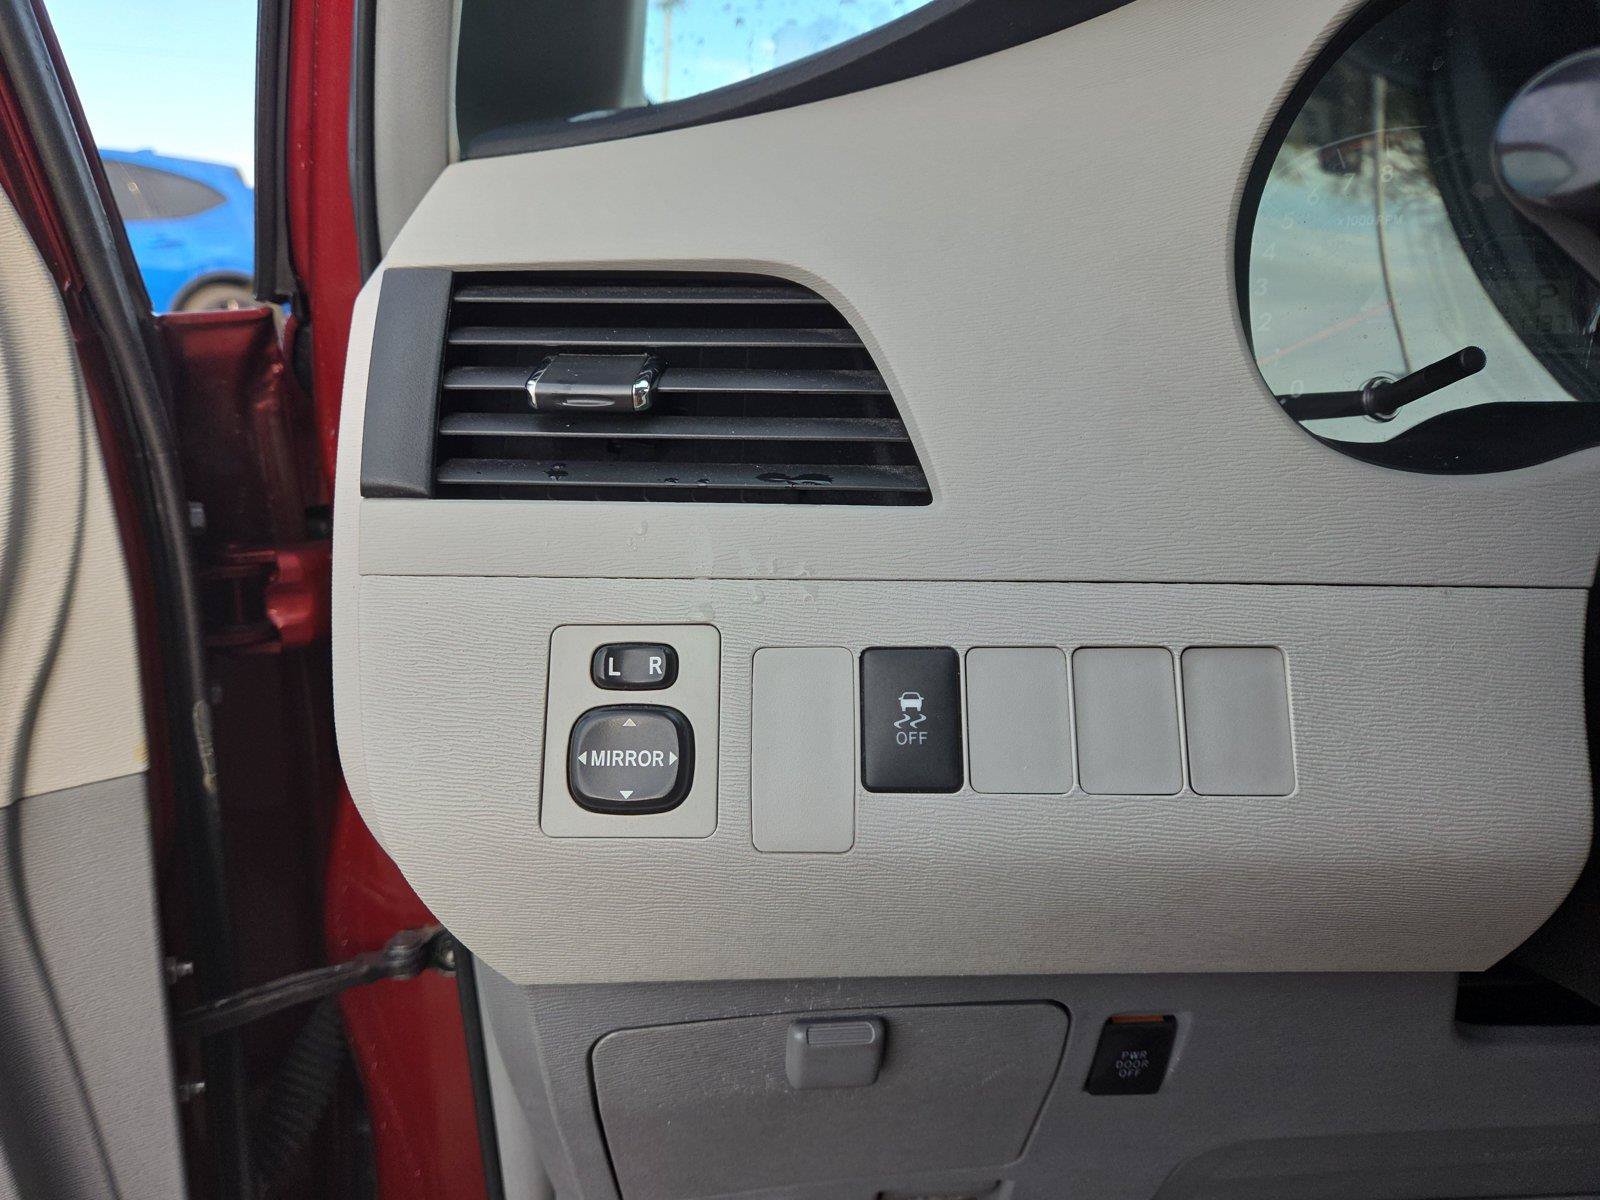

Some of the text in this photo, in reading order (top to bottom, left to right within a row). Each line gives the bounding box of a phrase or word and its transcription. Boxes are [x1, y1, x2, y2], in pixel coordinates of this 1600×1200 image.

[1379, 164, 1394, 183] 8
[1254, 277, 1269, 297] 3
[1256, 312, 1272, 332] 2
[1289, 379, 1305, 398] 0
[608, 656, 663, 676] L R
[896, 731, 929, 746] OFF
[591, 750, 664, 767] MIRROR
[1121, 1050, 1148, 1060] PWR
[1115, 1059, 1150, 1070] DOOR
[1118, 1068, 1141, 1079] OFF
